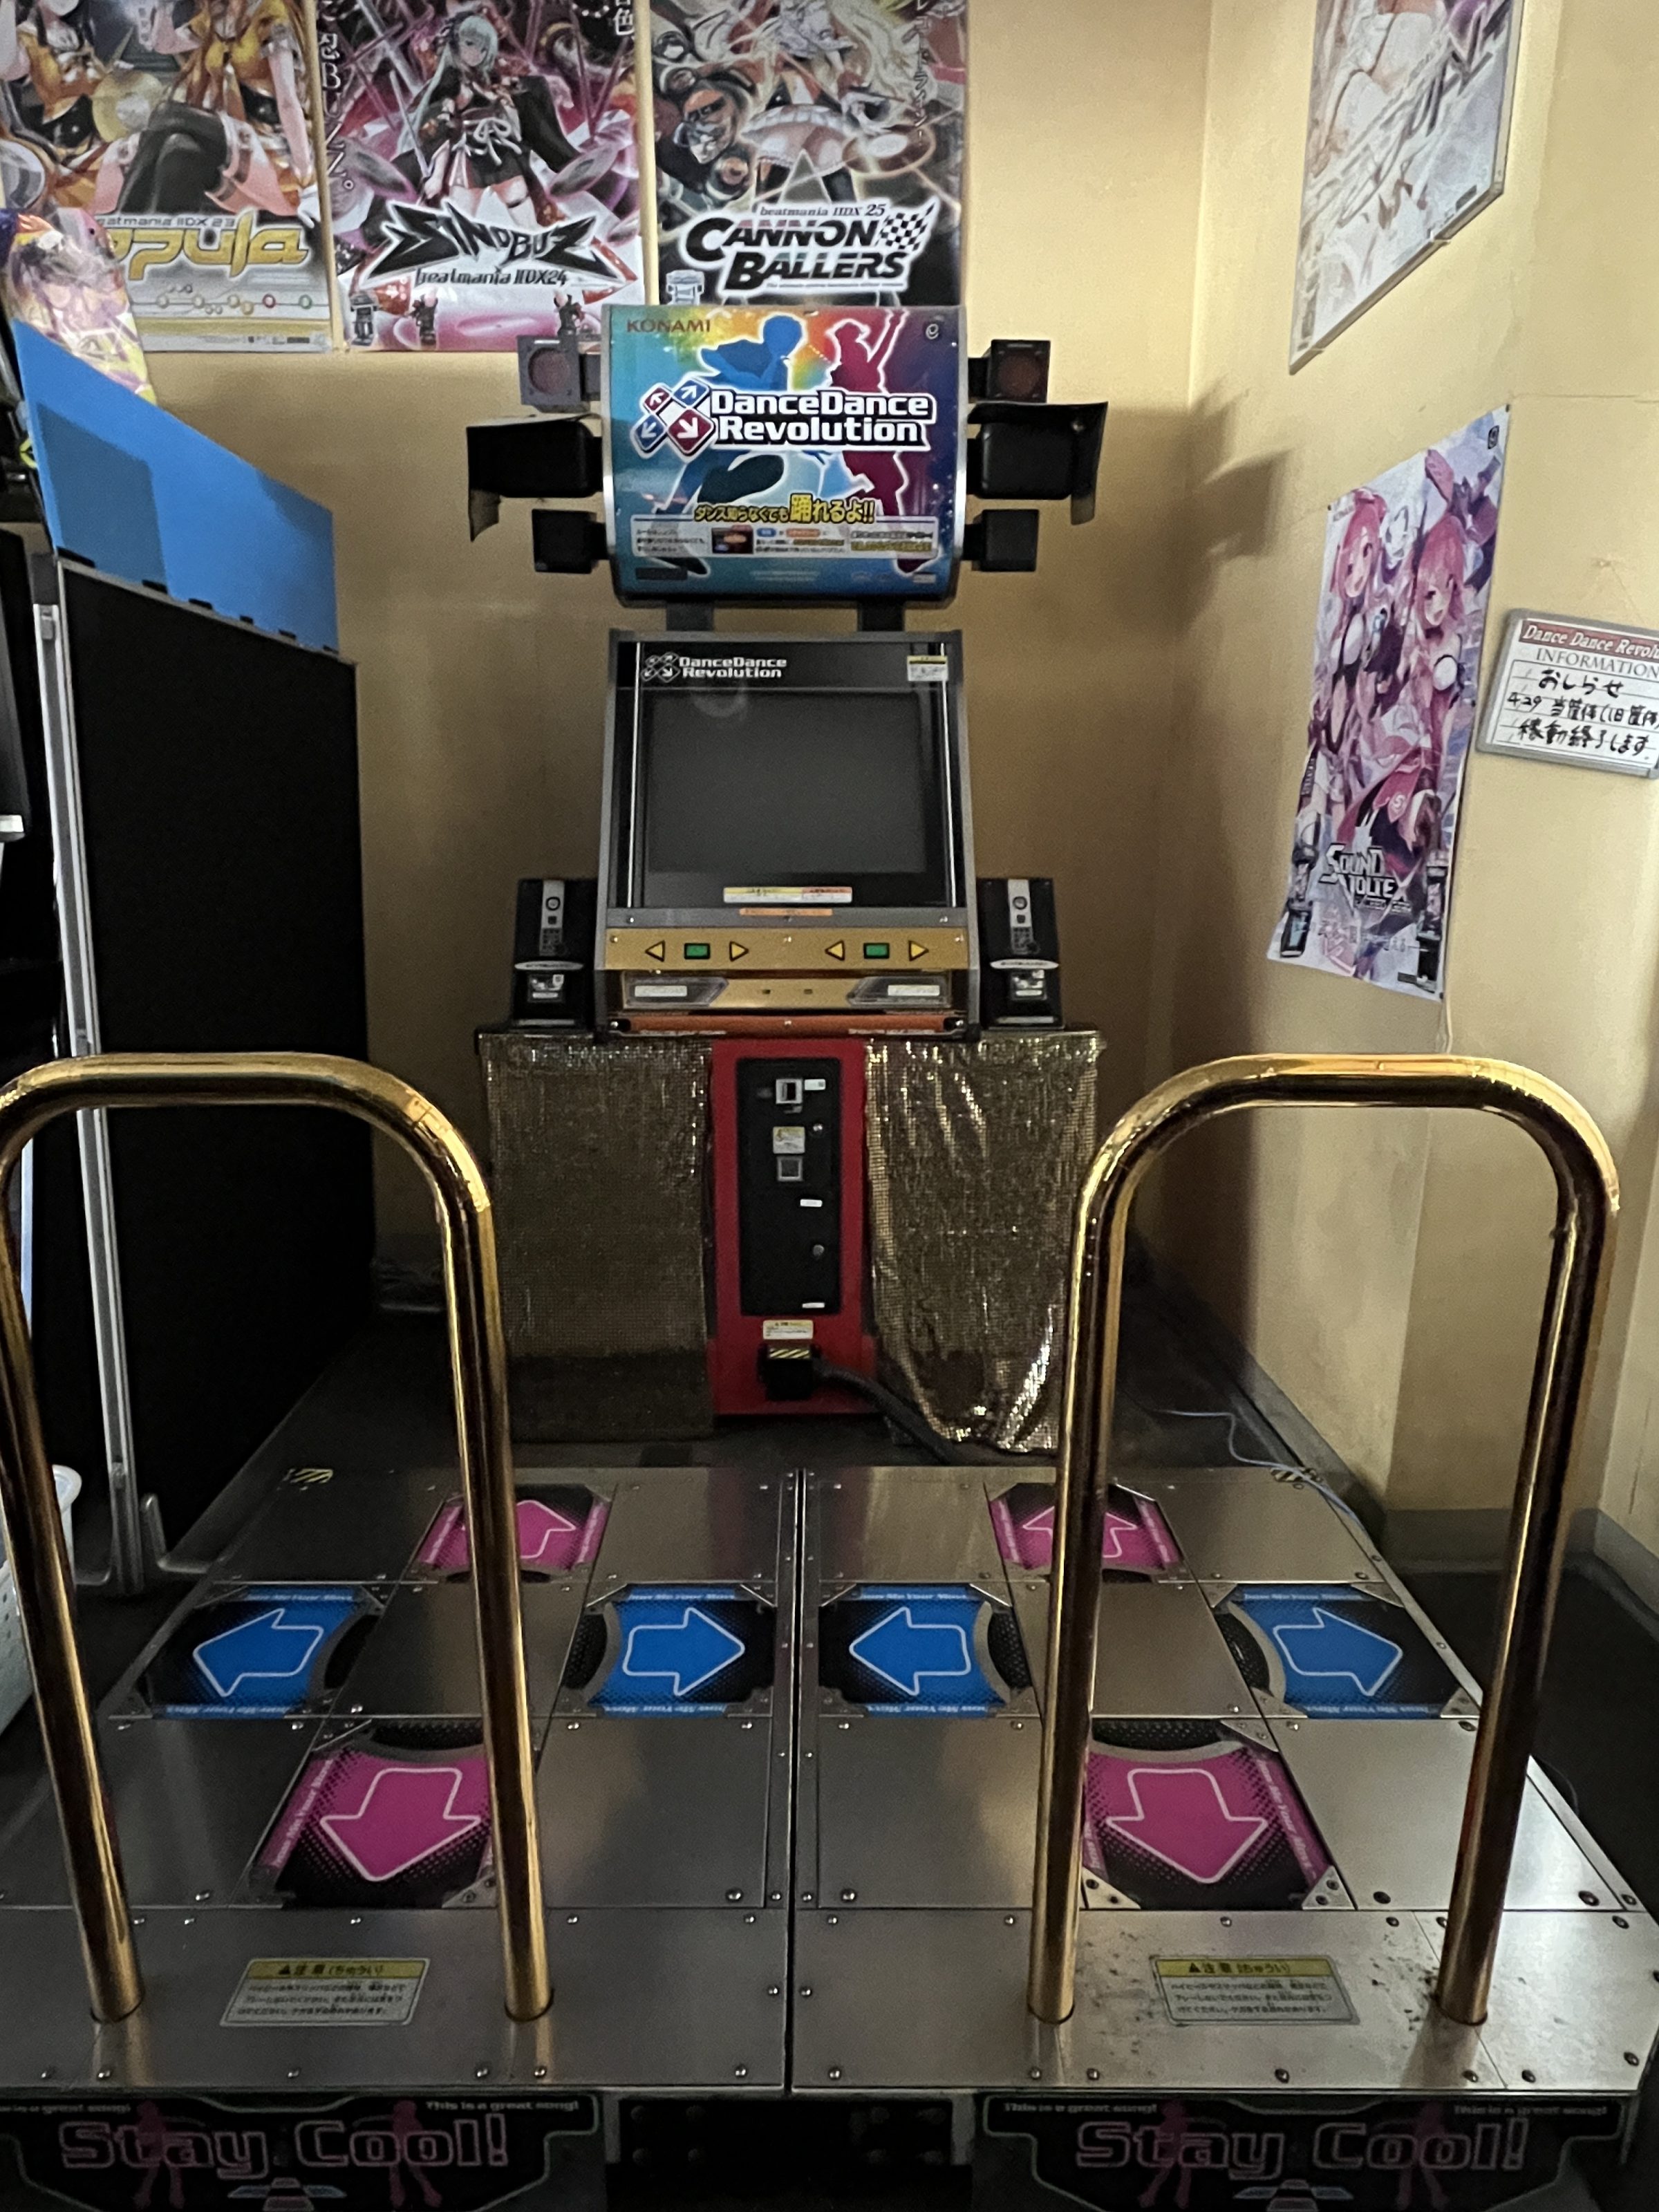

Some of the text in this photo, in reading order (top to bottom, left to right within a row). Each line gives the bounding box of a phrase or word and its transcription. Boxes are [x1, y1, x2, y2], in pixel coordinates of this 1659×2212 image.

[97, 217, 172, 227] eatmania
[212, 217, 236, 227] 23
[760, 203, 886, 216] beatmania IIDX 25
[368, 201, 619, 279] SINOBUZ
[685, 217, 880, 262] CANNON
[416, 268, 511, 285] beatmania
[724, 251, 910, 290] BALLERS
[626, 319, 711, 332] KONAMI
[711, 391, 929, 415] DanceDance
[718, 416, 922, 442] Revolution
[1522, 624, 1568, 644] Dance
[1569, 632, 1614, 652] Dance
[679, 657, 787, 668] DanceDance
[682, 668, 782, 678] Revolution
[1538, 669, 1624, 698] おしらせ
[1318, 843, 1385, 885] SOUND
[58, 2112, 509, 2180] Stay Cool!
[1076, 2117, 1530, 2180] Stay Cool!
